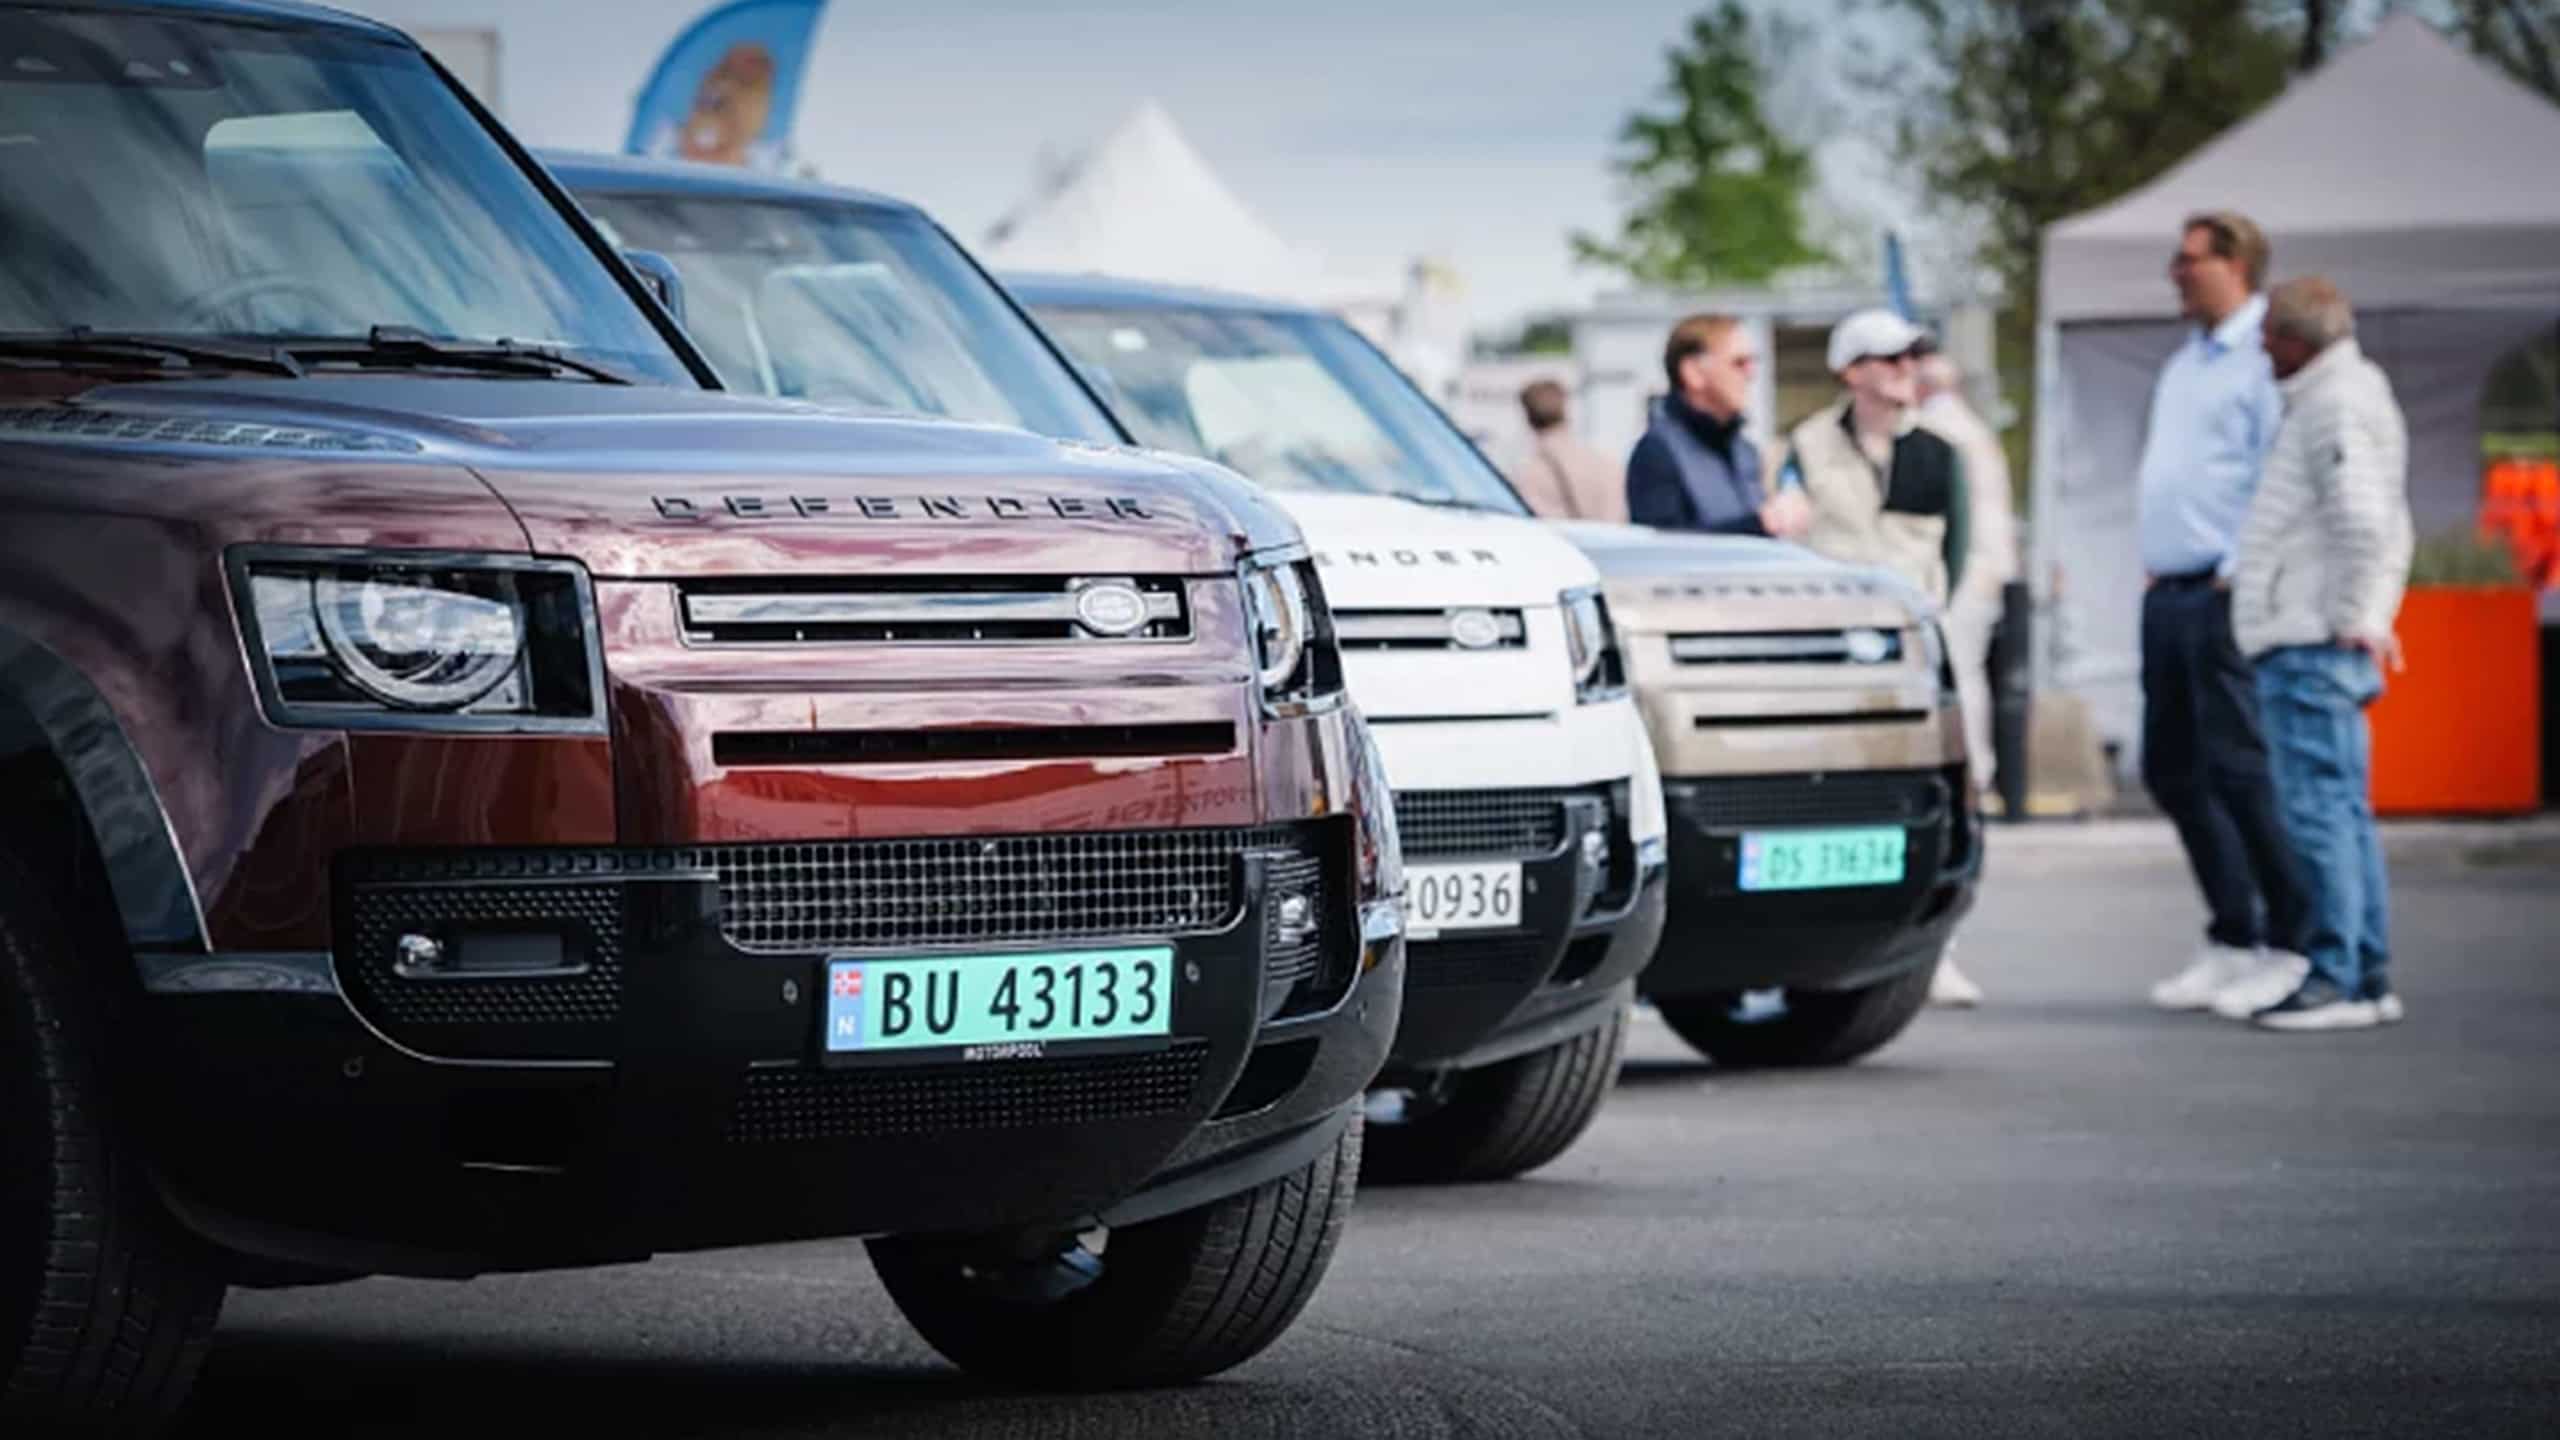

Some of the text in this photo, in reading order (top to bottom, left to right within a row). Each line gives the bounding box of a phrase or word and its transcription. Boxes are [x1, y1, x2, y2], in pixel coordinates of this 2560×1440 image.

[651, 495, 1153, 519] DEFENDER
[880, 960, 1156, 1037] BU 43133
[837, 1015, 855, 1037] N
